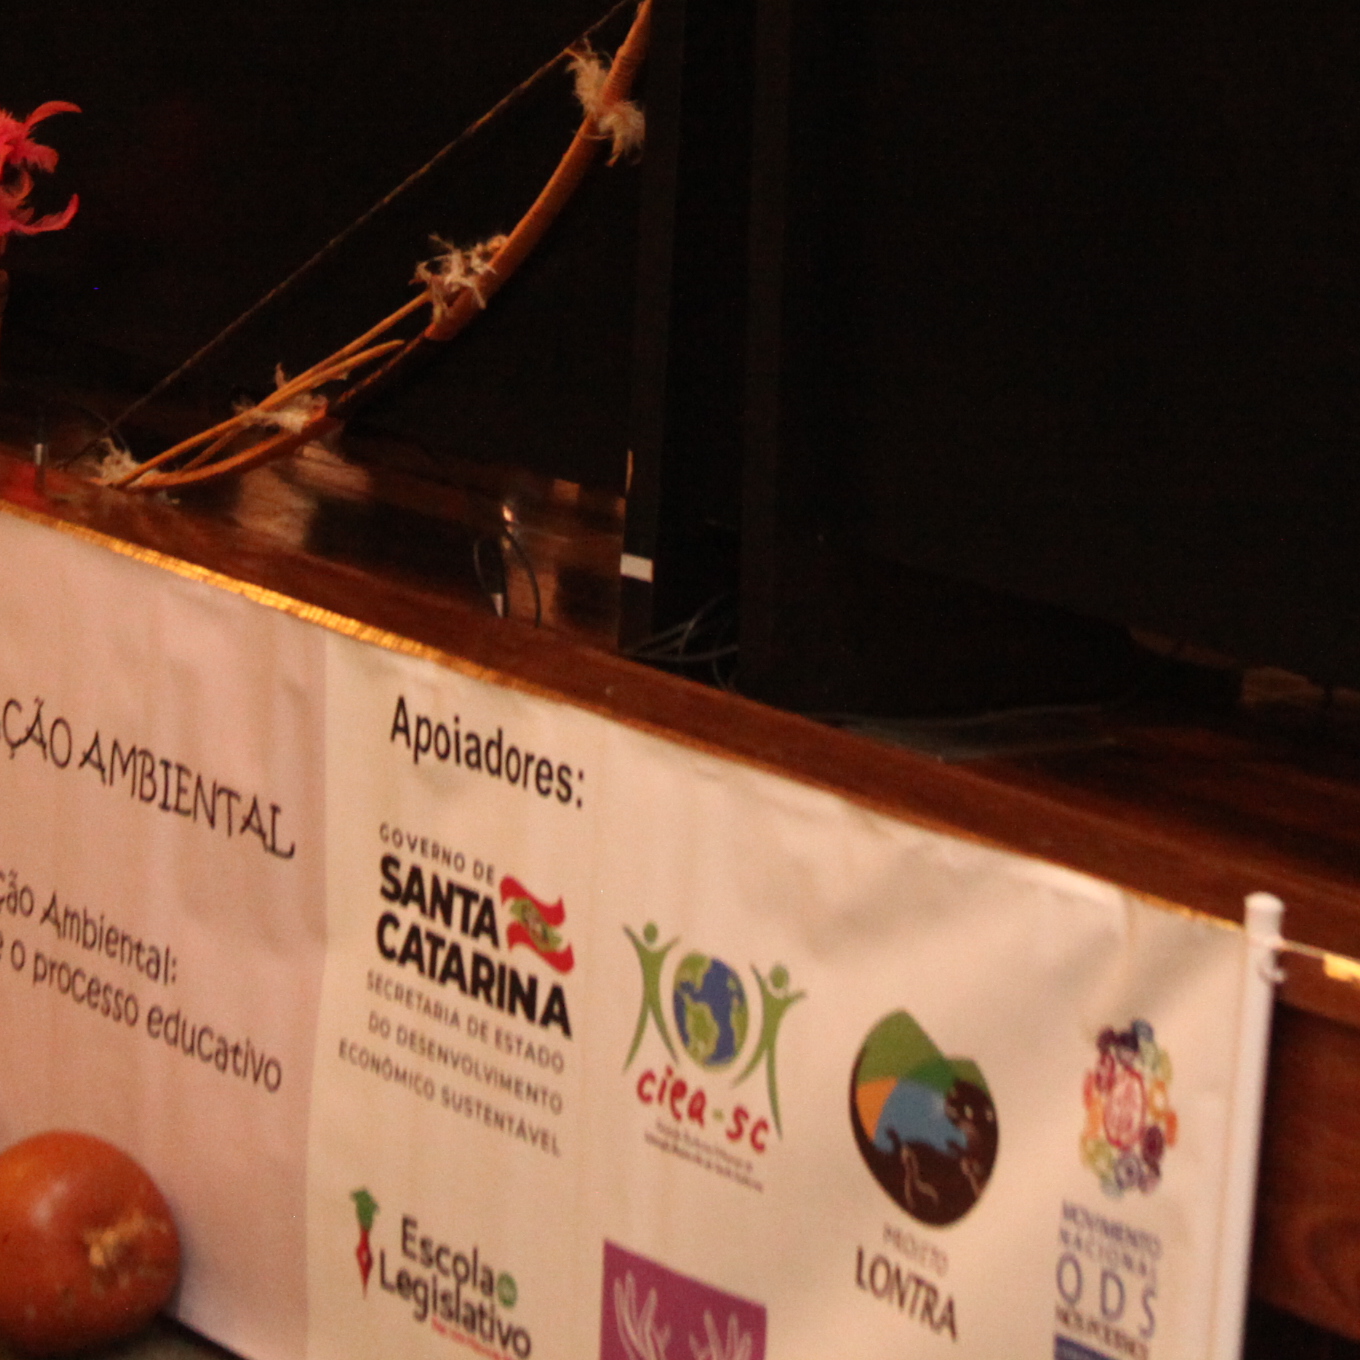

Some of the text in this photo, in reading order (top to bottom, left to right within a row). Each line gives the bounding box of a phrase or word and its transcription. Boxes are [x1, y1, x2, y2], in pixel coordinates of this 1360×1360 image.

[78, 730, 296, 859] AMBIENTAL
[390, 694, 586, 810] Apoiadores:
[379, 821, 495, 887] GOVERNO DE
[379, 852, 500, 951] SANTA
[40, 891, 178, 987] Ambiental:
[376, 910, 573, 1041] CATARINA
[10, 938, 26, 972] o
[33, 949, 140, 1028] processo
[146, 1005, 282, 1094] educativo
[367, 968, 565, 1075] SECRETARIA DE ESTADO
[368, 1009, 564, 1116] DO DESENVOLVIMENTO
[339, 1036, 436, 1102] ECONÔMICO
[440, 1085, 561, 1158] SUSTENTÁVEL
[379, 1246, 533, 1360] Legislativo
[401, 1213, 495, 1297] Escola
[856, 1244, 958, 1343] LONTRA
